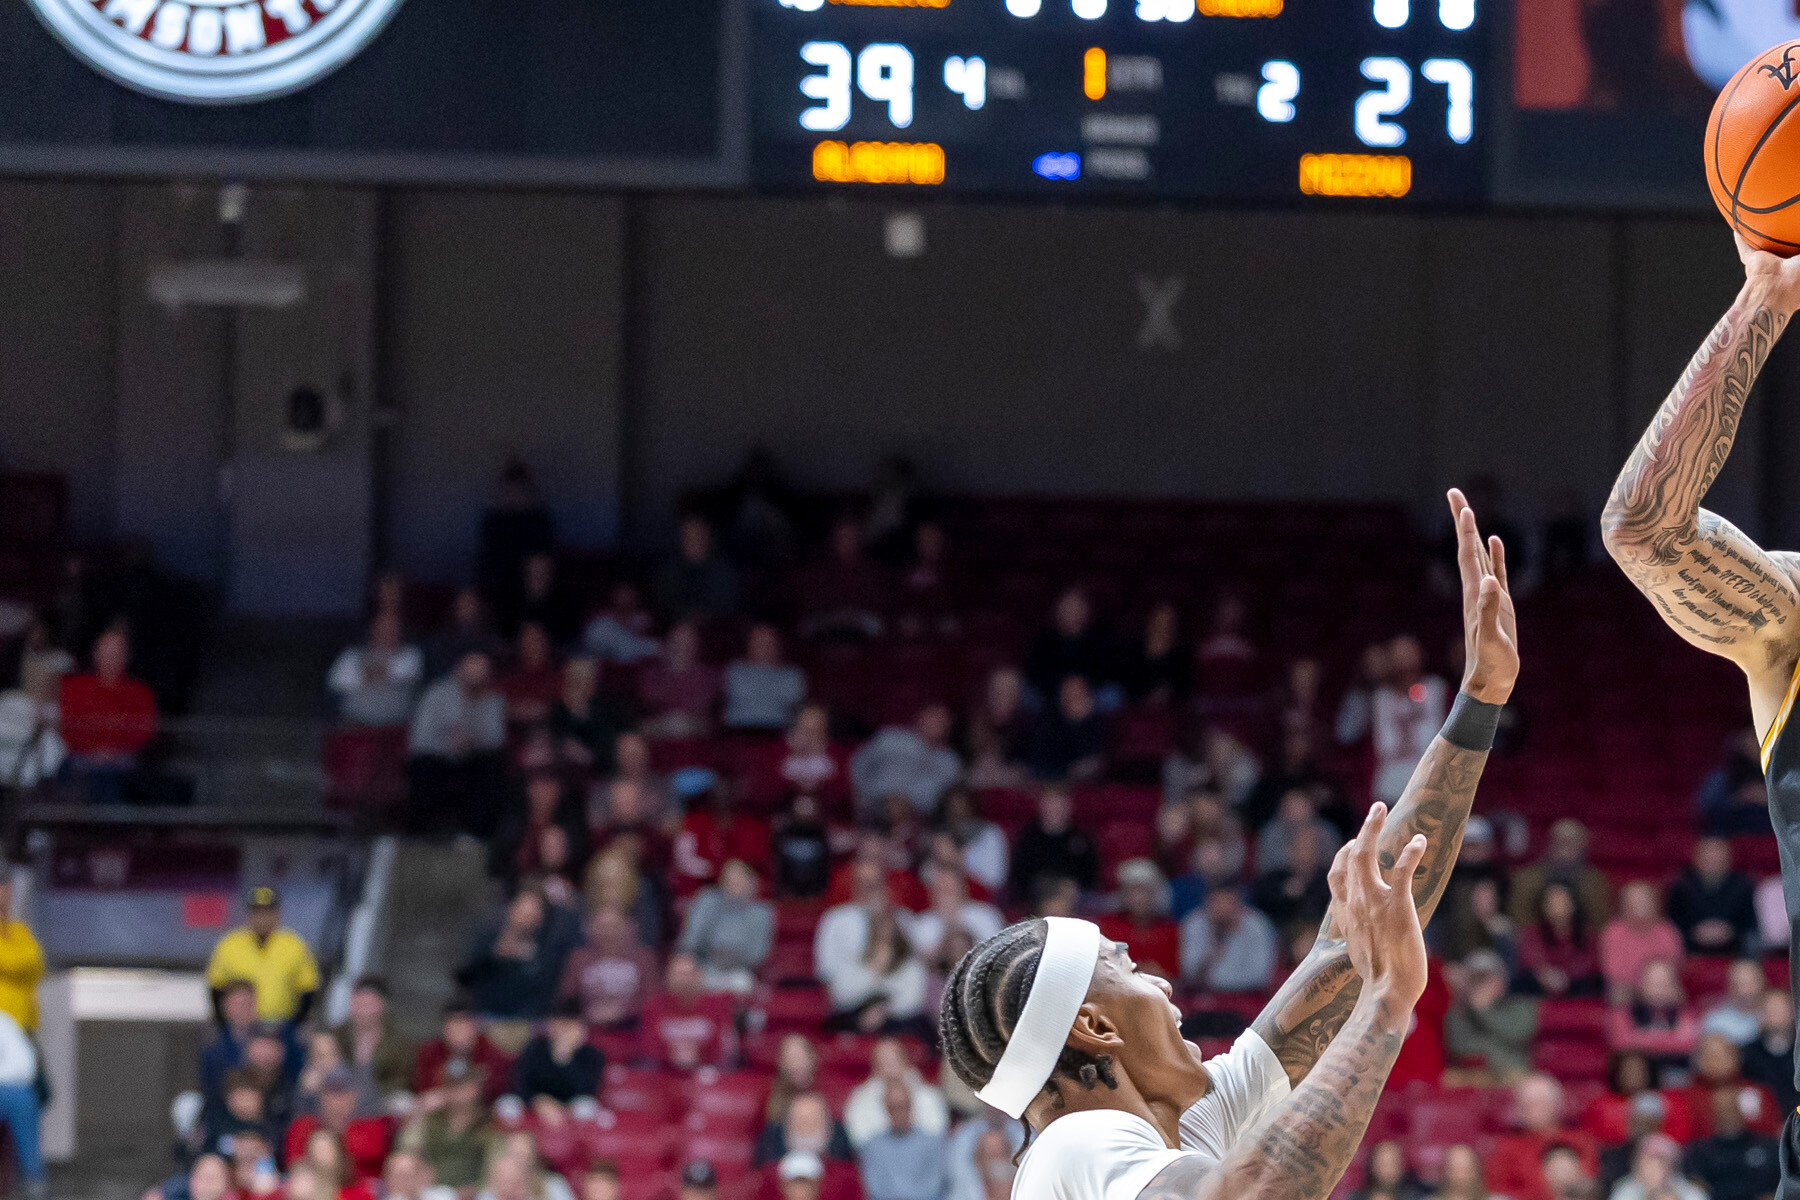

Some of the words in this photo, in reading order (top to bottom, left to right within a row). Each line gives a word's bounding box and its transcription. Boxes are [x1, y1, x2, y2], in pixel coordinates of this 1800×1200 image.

[799, 41, 914, 131] 39
[943, 56, 986, 110] 4
[1257, 59, 1300, 122] 2
[1354, 57, 1473, 147] 27
